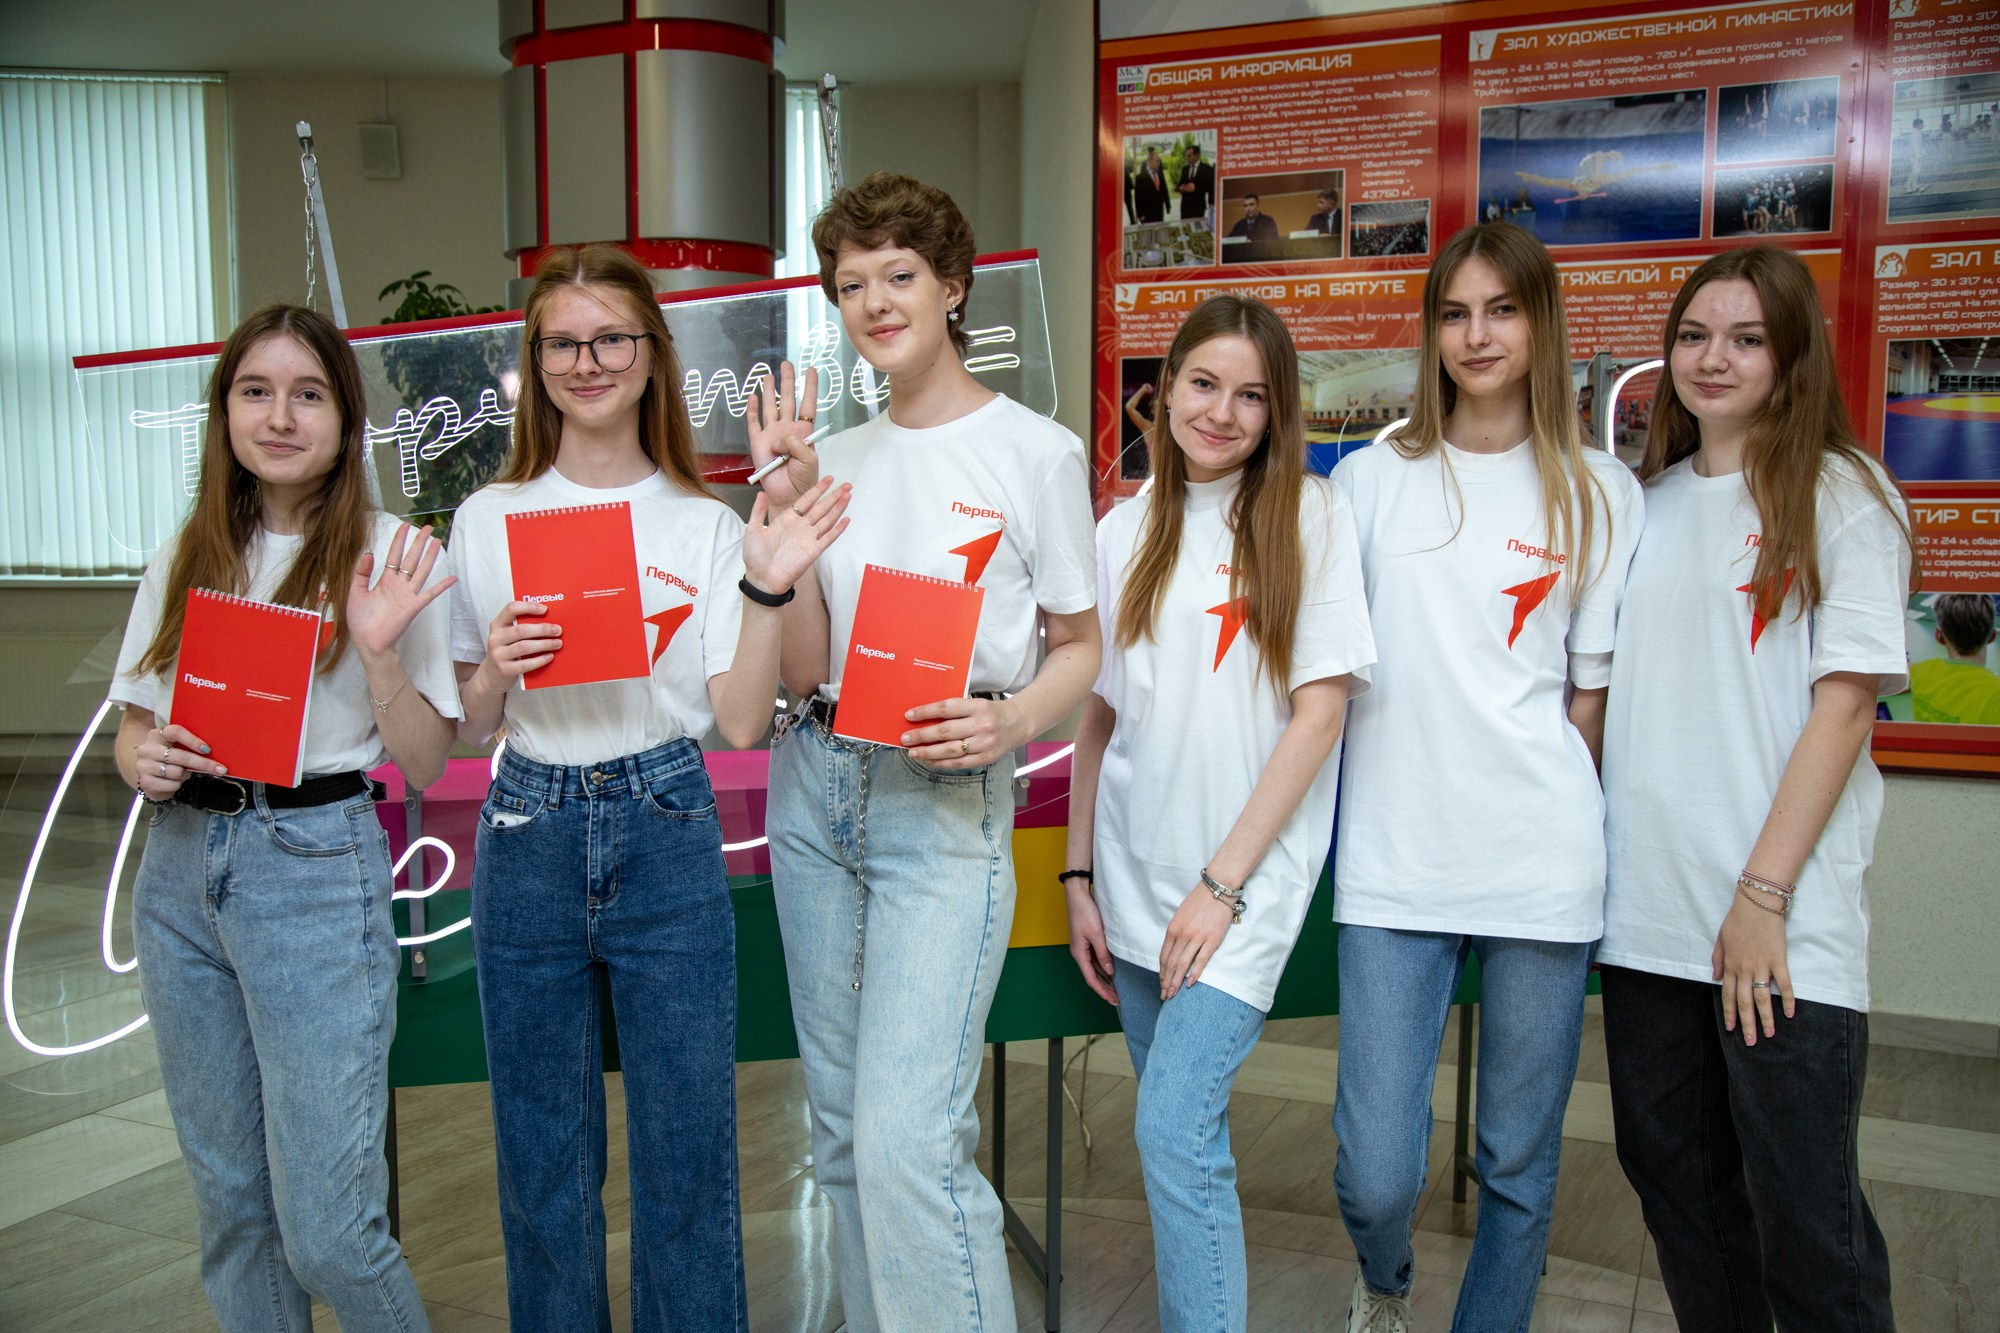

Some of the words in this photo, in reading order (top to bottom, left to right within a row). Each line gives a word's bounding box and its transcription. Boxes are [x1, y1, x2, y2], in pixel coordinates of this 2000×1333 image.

[1504, 36, 1538, 51] ЗАЛ
[1546, 15, 1716, 47] ХУДОЖЕСТВЕННОЙ
[1725, 2, 1854, 29] ГИМНАСТИКИ
[1894, 20, 1935, 30] Размер
[1947, 15, 1963, 24] 30
[1893, 40, 1956, 51] заниматься
[1960, 36, 1976, 45] 64
[1894, 33, 1903, 41] В
[1905, 31, 1932, 40] этом
[1474, 68, 1508, 76] Размер
[1518, 64, 1532, 73] 24
[1544, 62, 1558, 70] 30
[1572, 59, 1601, 68] общая
[1604, 55, 1644, 64] площадь
[1656, 50, 1677, 60] 720
[1696, 46, 1733, 56] высота
[1736, 41, 1783, 51] потолков
[1795, 38, 1803, 46] 11
[1806, 35, 1844, 45] метров
[1893, 51, 1966, 64] соревнования
[1150, 68, 1212, 86] ОБЩАЯ
[1221, 53, 1352, 80] ИНФОРМАЦИЯ
[1488, 78, 1510, 88] двух
[1513, 75, 1544, 84] коврах
[1572, 70, 1601, 78] могут
[1604, 64, 1665, 76] проводиться
[1667, 57, 1736, 69] соревнования
[1740, 53, 1775, 64] уровня
[1892, 62, 1959, 75] зрительских
[1962, 59, 1993, 68] мест.
[1473, 87, 1514, 99] Трибуны
[1516, 83, 1571, 95] рассчитаны
[1588, 78, 1605, 86] 100
[1608, 74, 1668, 86] зрительских
[1132, 96, 1151, 104] 2014
[1212, 86, 1268, 96] строительство
[1930, 251, 1982, 269] ЗАЛ
[1558, 264, 1661, 286] ТЯЖЕЛОЙ
[1880, 281, 1920, 289] Размер
[1931, 278, 1947, 287] 30
[1150, 289, 1187, 305] ЗАЛ
[1294, 283, 1322, 298] НА
[1330, 280, 1406, 296] БАТУТЕ
[1565, 295, 1594, 303] общая
[1596, 294, 1636, 303] площадь
[1880, 292, 1900, 300] Зал
[1902, 290, 1976, 301] предназначен
[1979, 288, 1998, 298] для
[1637, 304, 1655, 313] для
[1879, 303, 1927, 311] вольного
[1878, 313, 1940, 322] заниматься
[1942, 311, 1959, 319] 60
[1877, 324, 1928, 334] Спортзал
[1913, 509, 1960, 524] ТИР
[1507, 539, 1567, 564] Первые
[1930, 549, 1948, 557] тир
[646, 566, 699, 597] Первые
[522, 592, 564, 604] Первые
[856, 644, 896, 660] Первые
[184, 673, 226, 691] Первые
